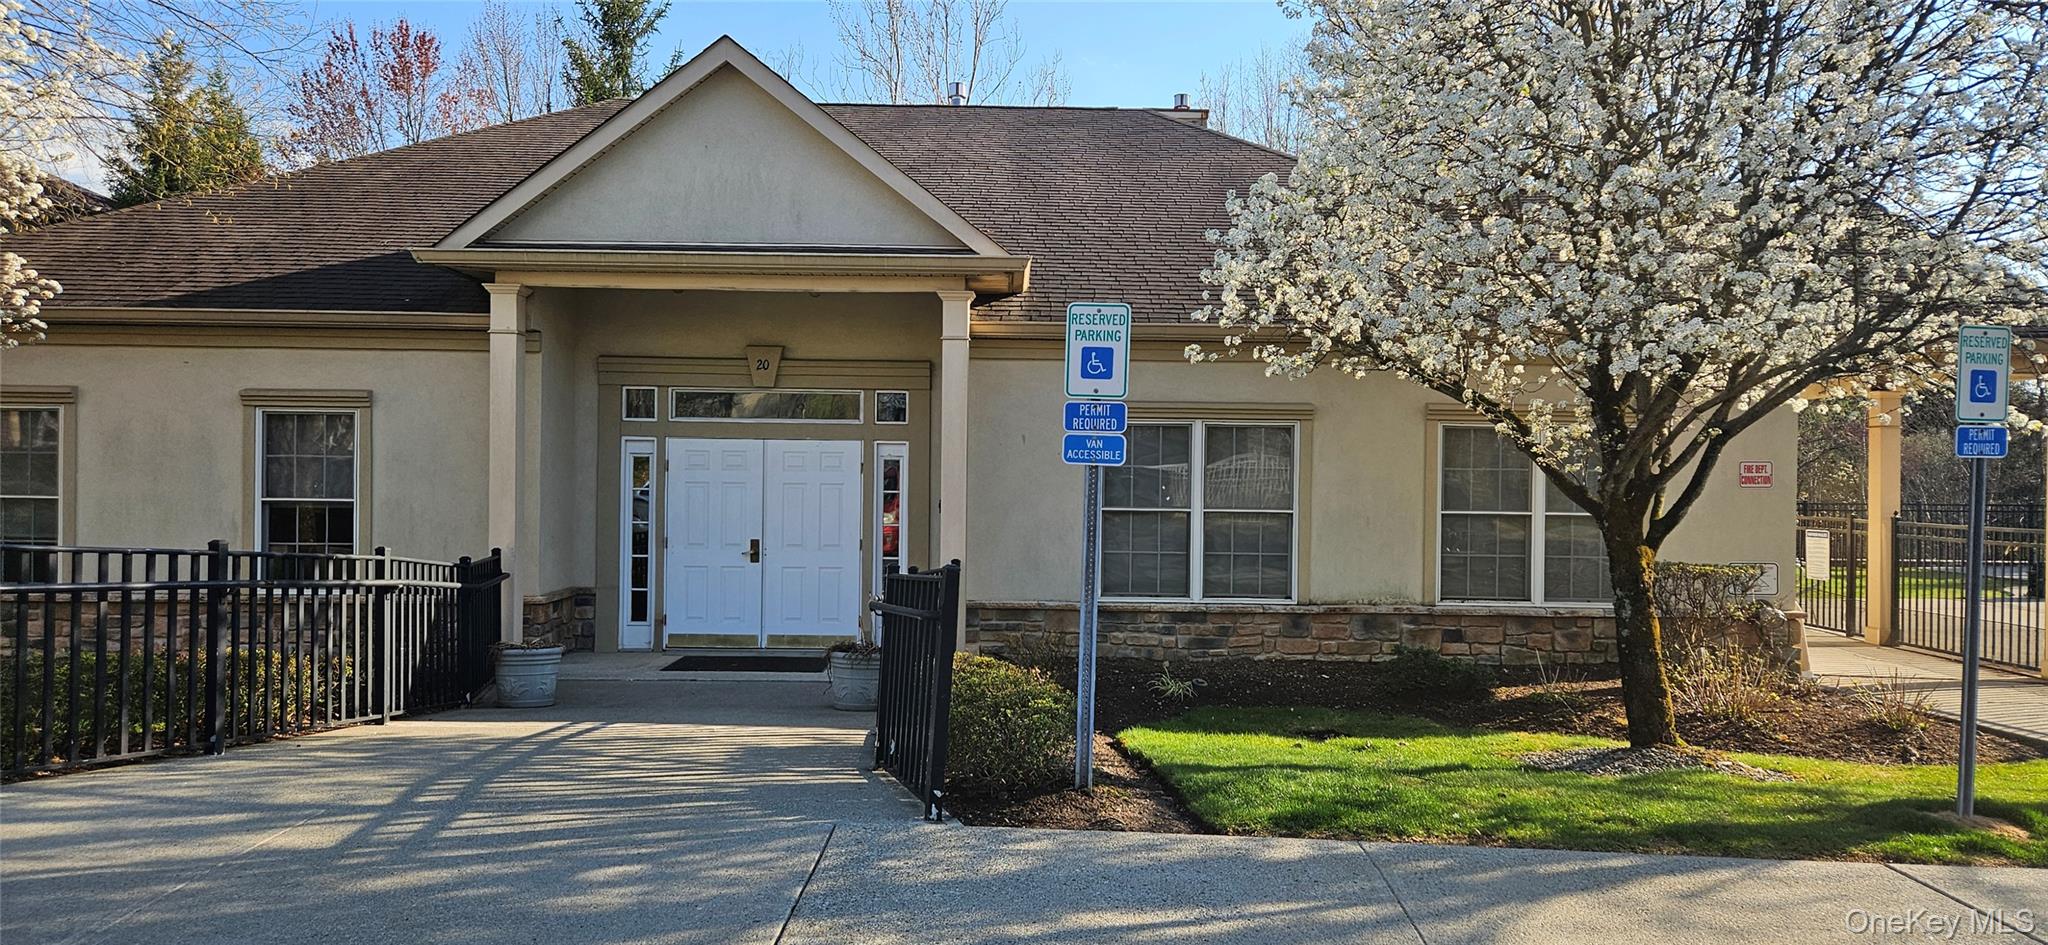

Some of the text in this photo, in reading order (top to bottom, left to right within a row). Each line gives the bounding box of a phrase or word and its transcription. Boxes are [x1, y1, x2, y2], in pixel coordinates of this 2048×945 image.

[1072, 313, 1126, 326] RESERVED
[1075, 329, 1122, 342] PARKING
[1963, 335, 2008, 349] RESERVED
[1965, 351, 2004, 365] PARKING
[756, 359, 770, 371] 20
[1079, 404, 1111, 417] PERMIT
[1072, 417, 1118, 431] REQUIRED
[1968, 428, 1996, 441] PERMIT
[1086, 439, 1104, 449] VAN
[1963, 442, 2001, 455] REQUIRED
[1066, 449, 1121, 460] ACCESSIBLE
[1743, 464, 1754, 474] FIRE
